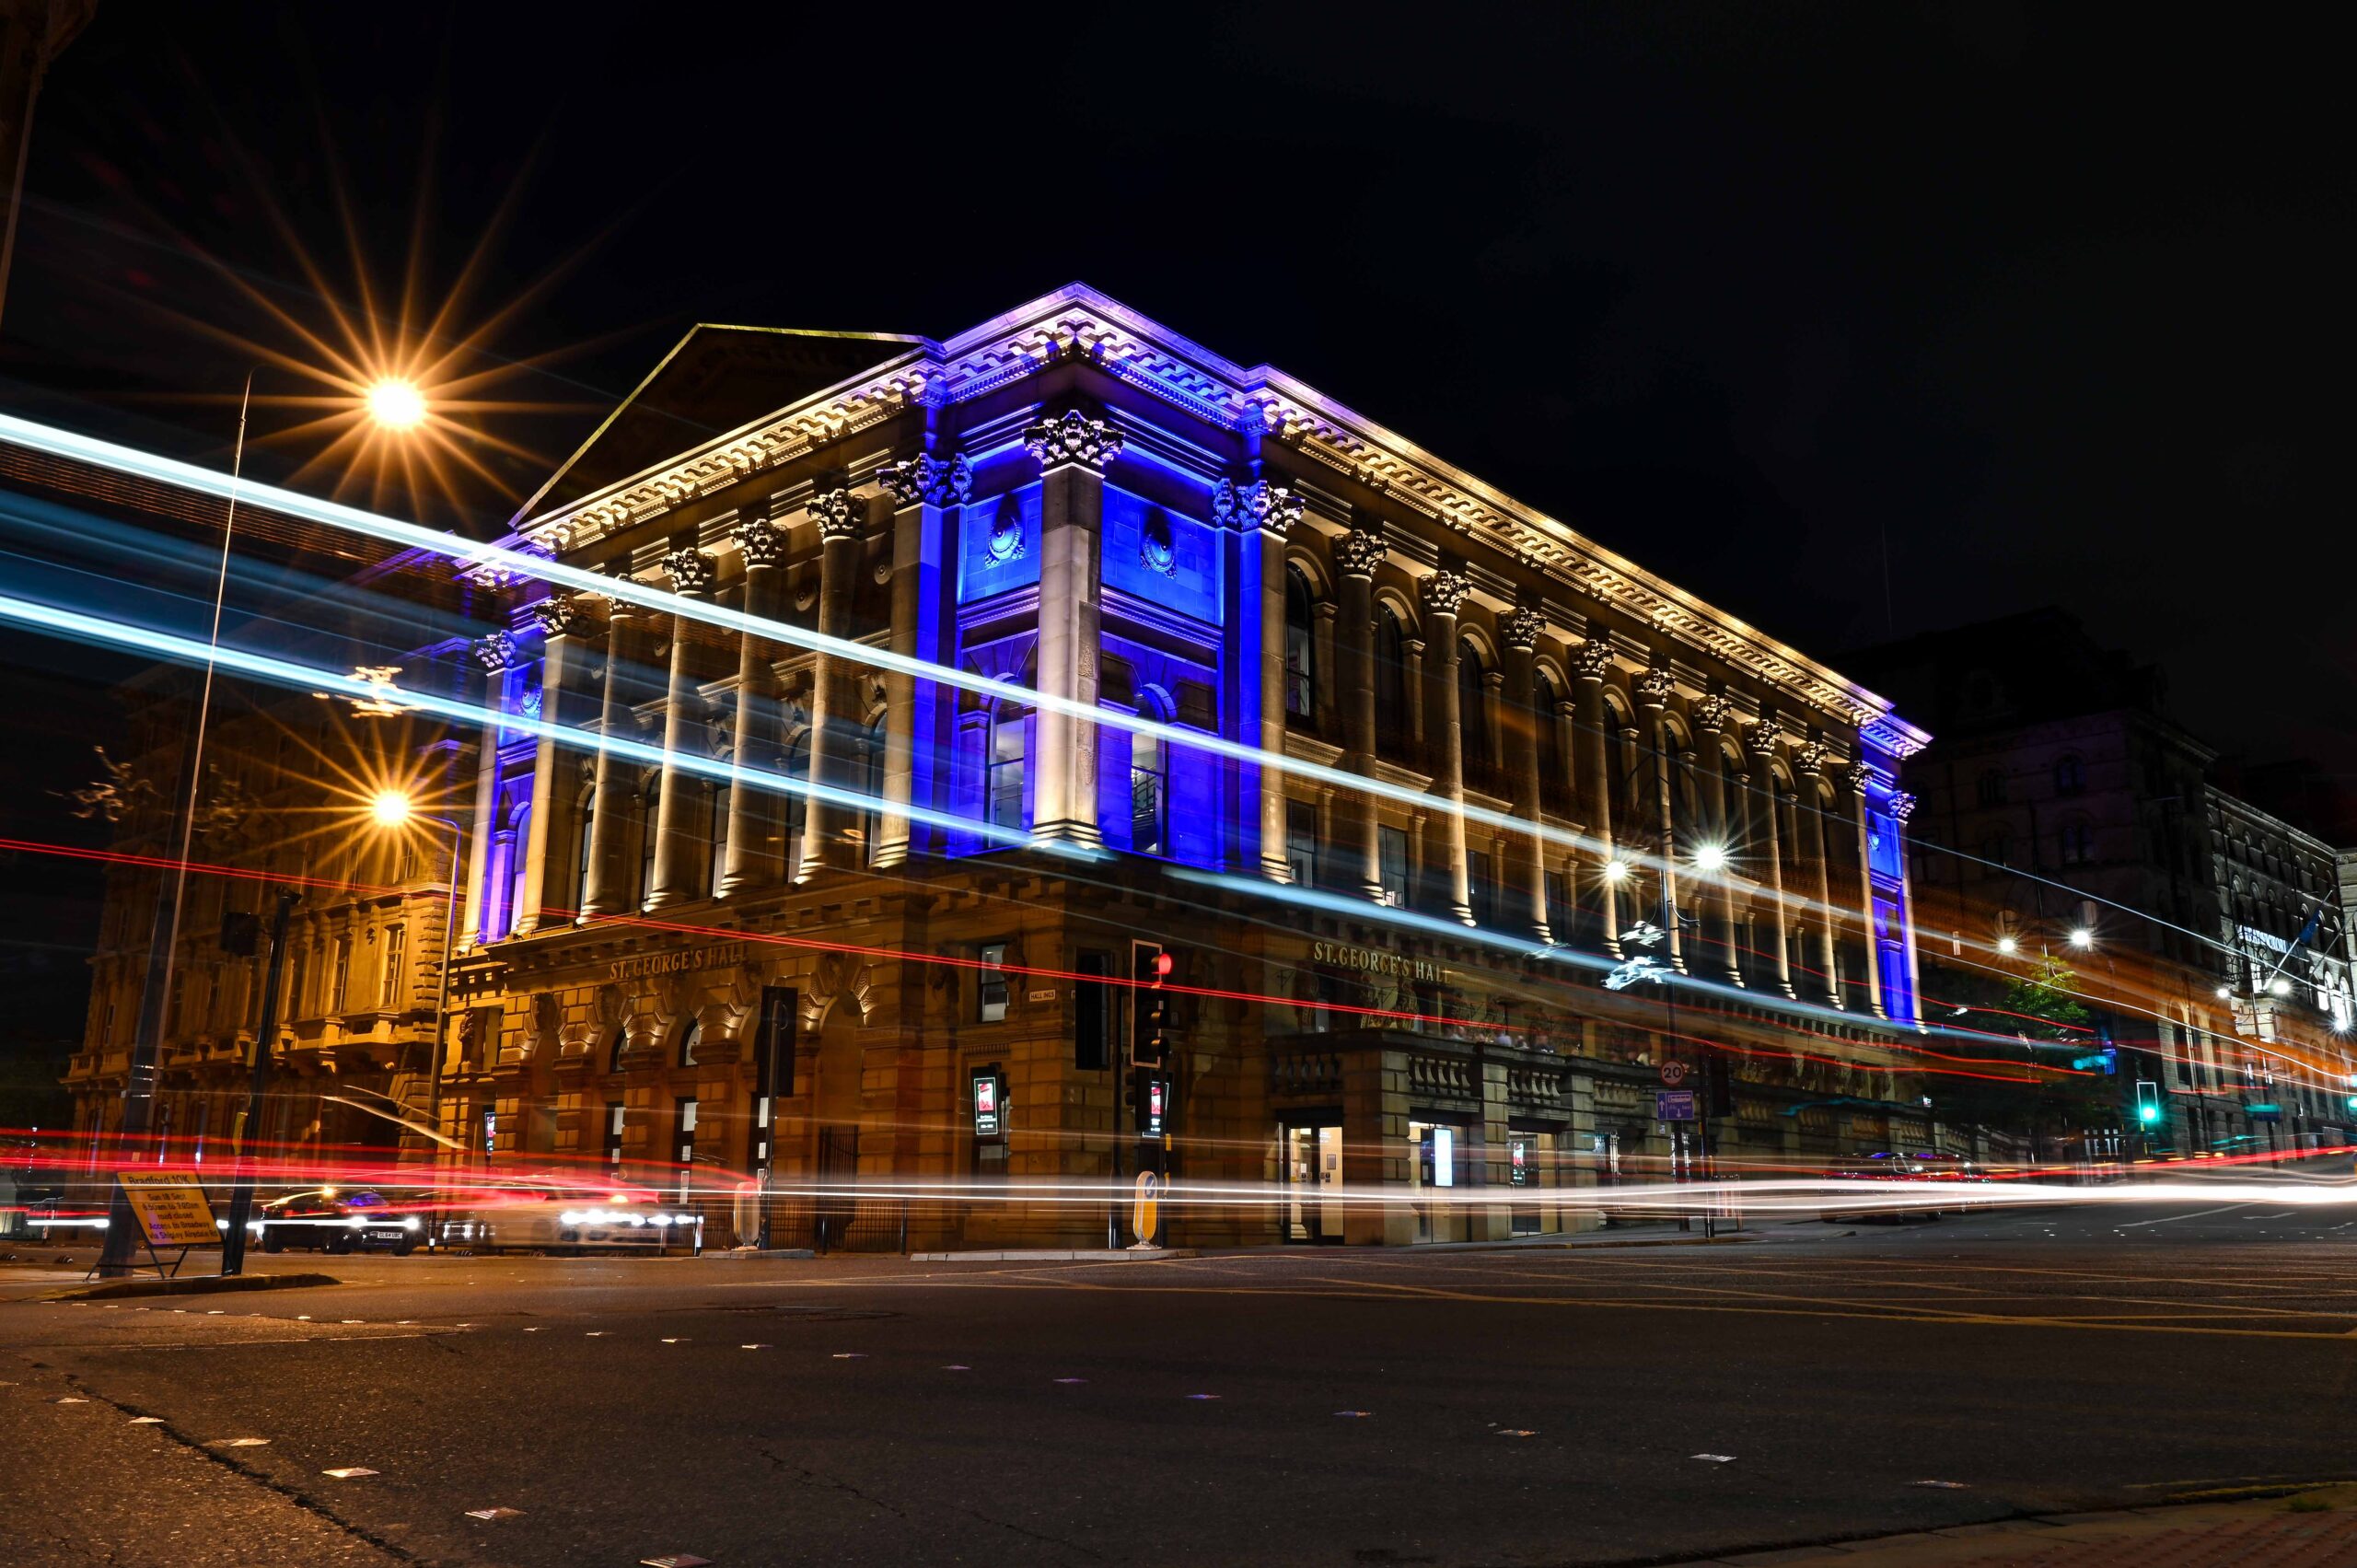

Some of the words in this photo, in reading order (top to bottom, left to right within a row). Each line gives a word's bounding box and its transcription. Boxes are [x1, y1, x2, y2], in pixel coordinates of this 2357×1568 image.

[707, 943, 748, 967] HALL
[1415, 960, 1452, 984] HALL
[1664, 1067, 1682, 1078] 20
[127, 1175, 171, 1185] Bradford
[172, 1174, 191, 1185] 10K
